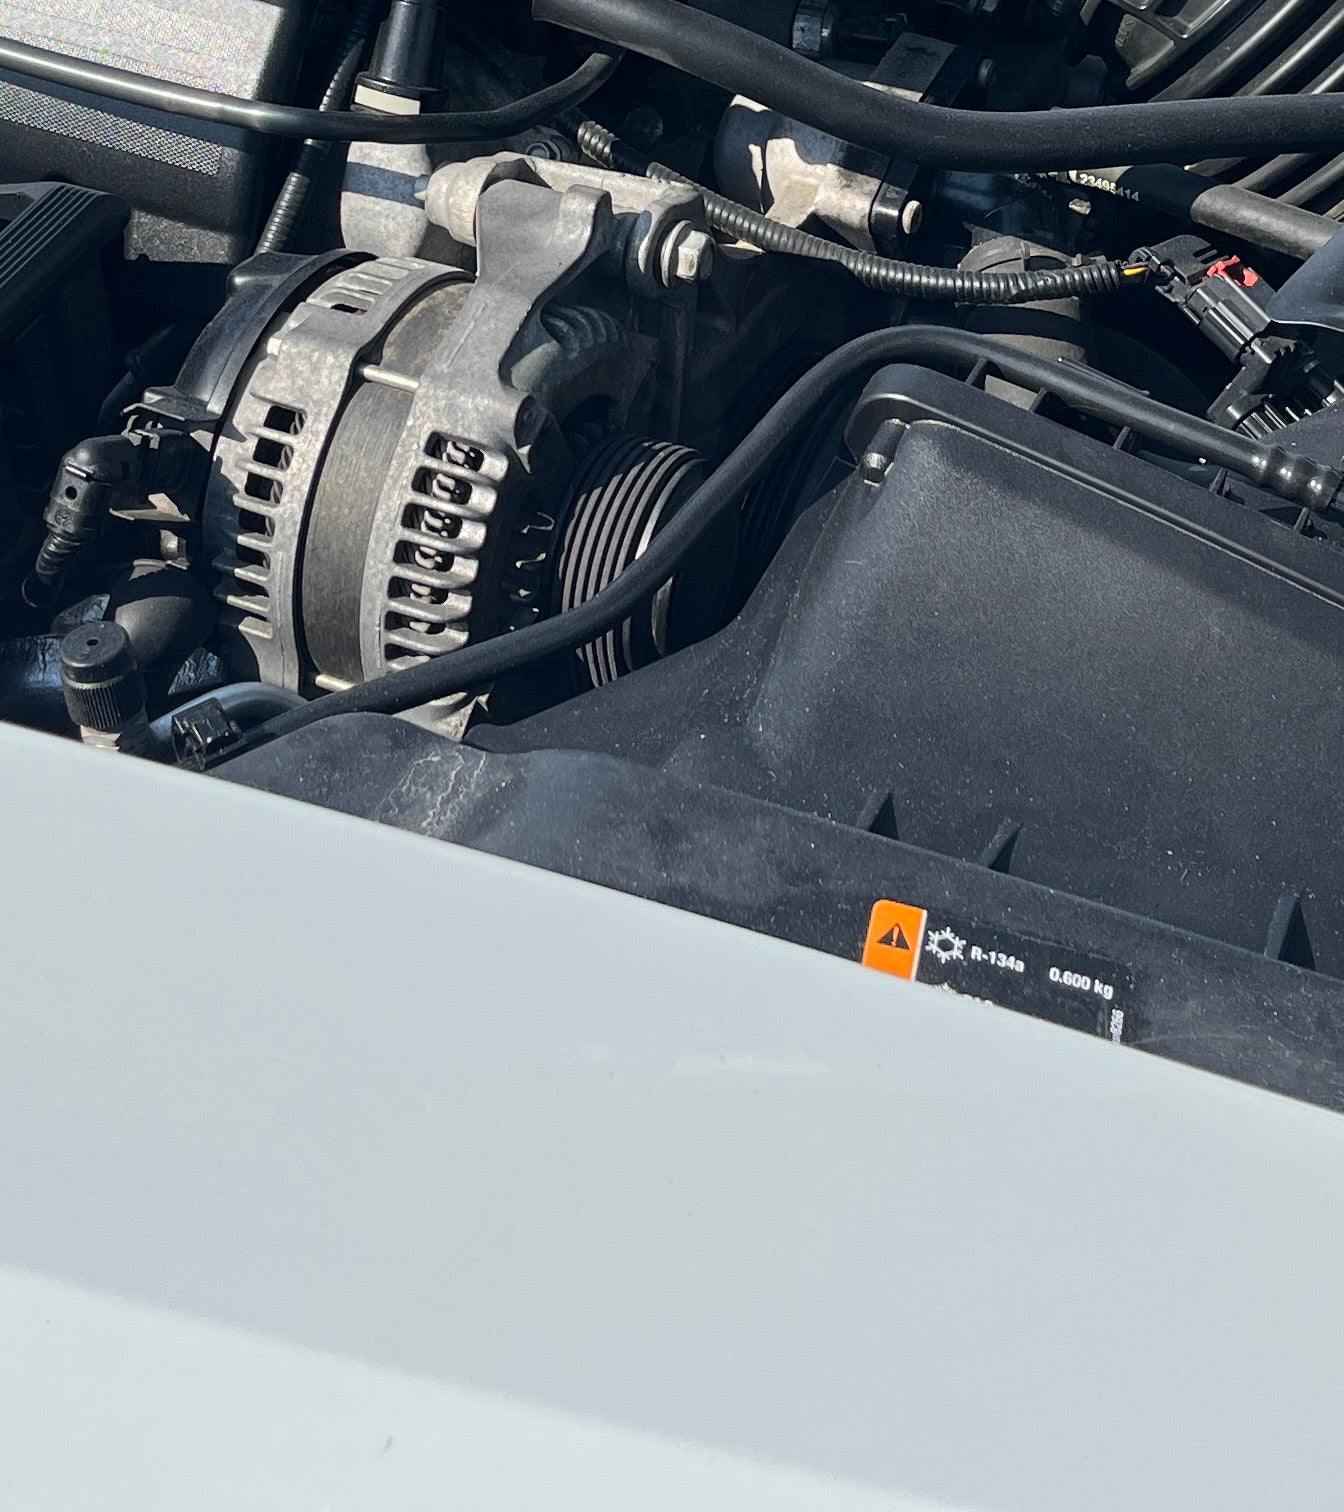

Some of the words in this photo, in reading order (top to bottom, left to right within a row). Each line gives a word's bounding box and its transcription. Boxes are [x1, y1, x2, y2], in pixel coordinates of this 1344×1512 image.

[971, 946, 1025, 973] R-134a
[1049, 966, 1091, 992] 0.600
[1094, 979, 1114, 1000] kg
